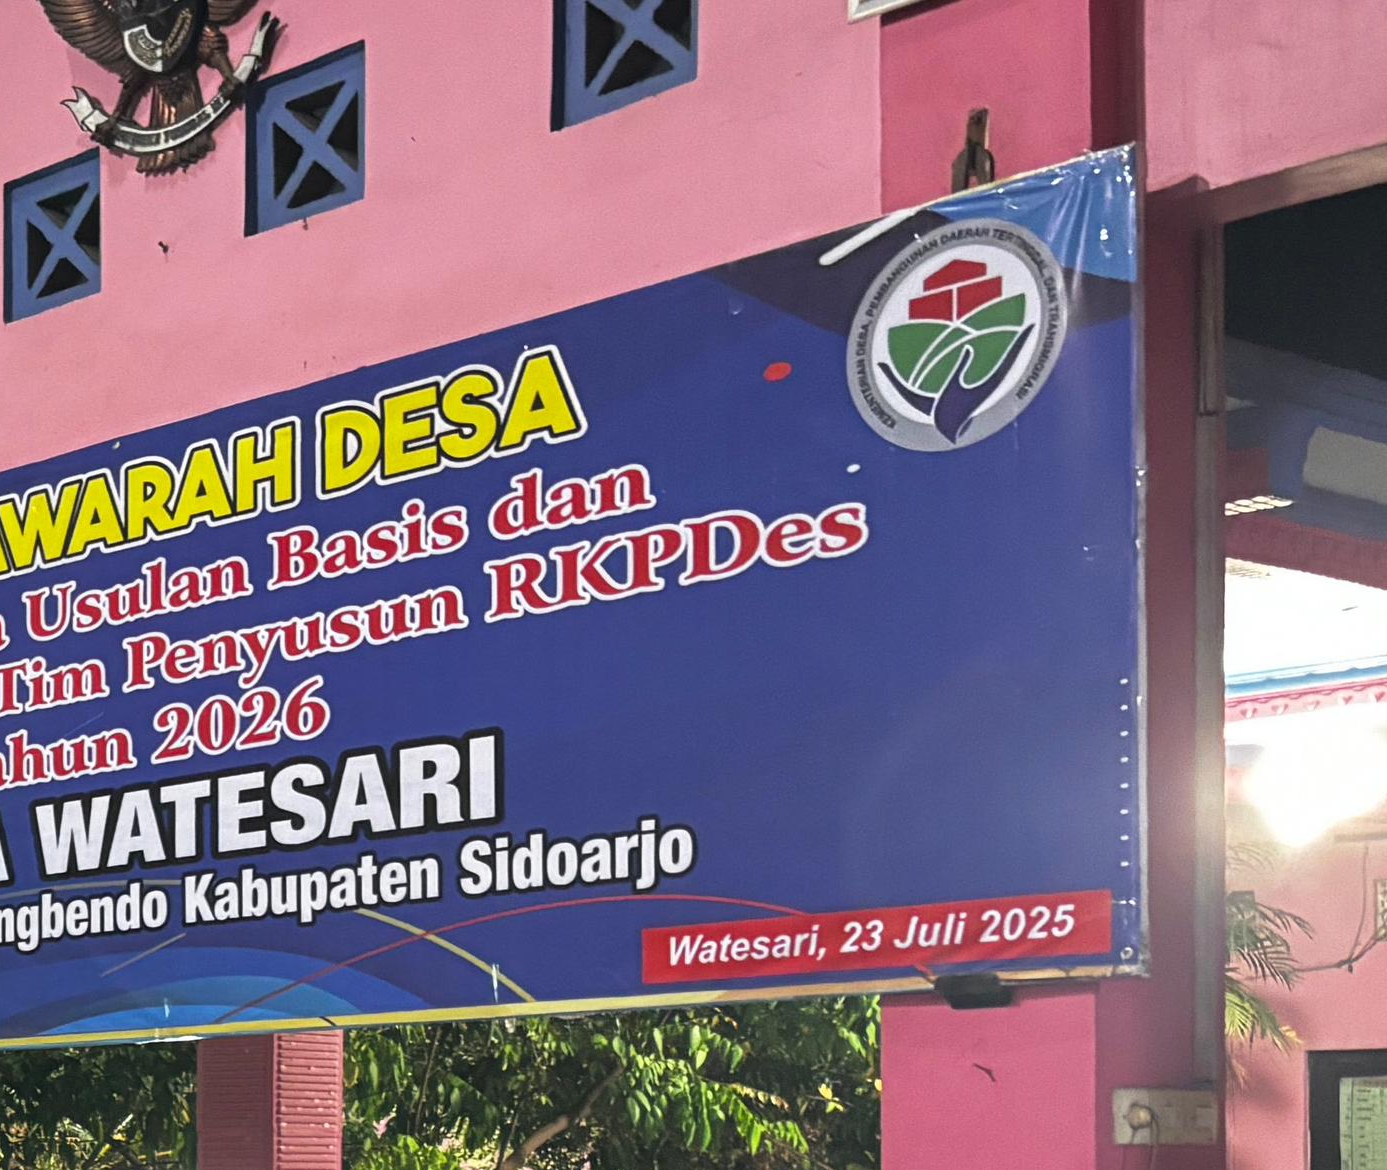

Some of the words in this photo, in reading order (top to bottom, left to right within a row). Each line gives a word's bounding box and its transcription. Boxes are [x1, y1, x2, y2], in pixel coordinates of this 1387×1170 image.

[322, 349, 582, 495] DESA
[26, 557, 249, 638] Usulan
[272, 501, 467, 588] Basis
[490, 466, 654, 538] dan
[124, 587, 468, 691] Penyusun
[486, 502, 869, 622] RKPDes
[152, 677, 329, 763] 2026
[35, 735, 497, 876] WATESARI
[184, 854, 440, 923] Kabupaten
[459, 819, 694, 895] Sidoarjo
[668, 925, 826, 967] Watesari,
[839, 919, 885, 954] 23
[893, 911, 968, 950] Juli
[979, 903, 1076, 944] 2025
